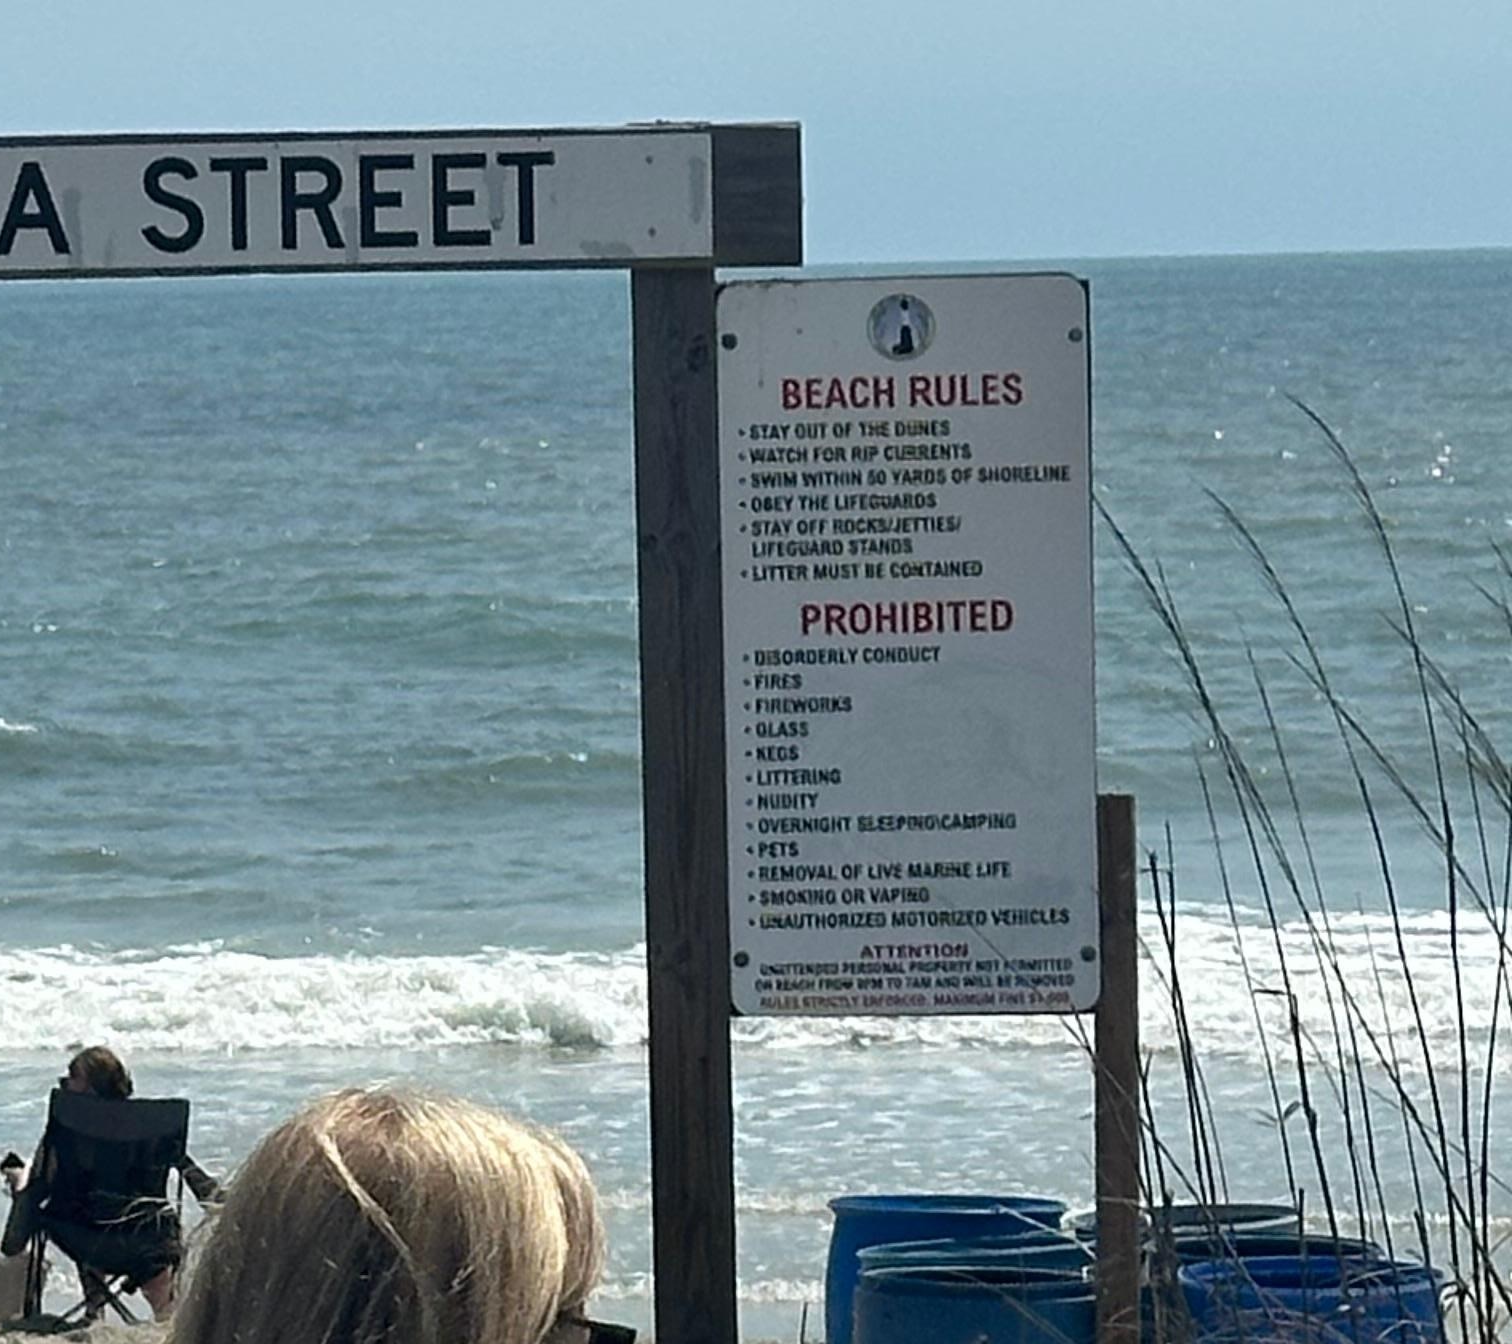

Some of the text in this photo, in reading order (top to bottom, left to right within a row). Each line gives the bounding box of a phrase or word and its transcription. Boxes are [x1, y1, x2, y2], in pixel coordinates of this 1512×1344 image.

[138, 146, 558, 254] STREET
[781, 372, 1023, 410] BEACH RULES
[748, 419, 952, 441] STAY OUT OF THE DUNES
[749, 443, 974, 464] WATCH FOR RIP CURRENTS
[750, 471, 799, 489] SWIM
[801, 470, 864, 488] WITHIN
[891, 468, 947, 486] YARDS
[950, 467, 974, 485] OF
[977, 465, 1072, 483] SHORELINE
[750, 492, 938, 513] OBEY THE LIFEGUARDS
[751, 520, 794, 537] STAY
[796, 519, 829, 536] OFF
[751, 538, 915, 558] LIFEGUARD STANDS
[752, 560, 984, 582] LITTER MUST BE CONTAINED
[800, 600, 1015, 635] PROHIBITED
[754, 646, 941, 666] DISORDERLY CONDUCT
[754, 673, 803, 690] FIRES
[754, 696, 854, 714] FIREWORKS
[755, 720, 810, 738] GLASS
[756, 745, 800, 762] KEGS
[756, 768, 843, 786] LITTERING
[757, 792, 820, 810] NUDITY
[757, 816, 852, 835] OVERNIGHT
[757, 841, 800, 859] PETS
[758, 860, 1013, 883] REMOVAL OF LIVE MARINE LIFE
[759, 886, 931, 906] SMOKING OR VAPING
[759, 908, 1071, 930] UNAUTHORIZED MOTORIZED VEHICLES
[859, 944, 969, 959] ATTENTION
[758, 962, 839, 976] UNATTENDED
[841, 961, 906, 975] PERSONAL
[908, 960, 974, 973] PROPERTY
[886, 976, 903, 989] TO
[934, 975, 961, 988] AND
[962, 975, 993, 987] WILL
[996, 974, 1012, 987] BE
